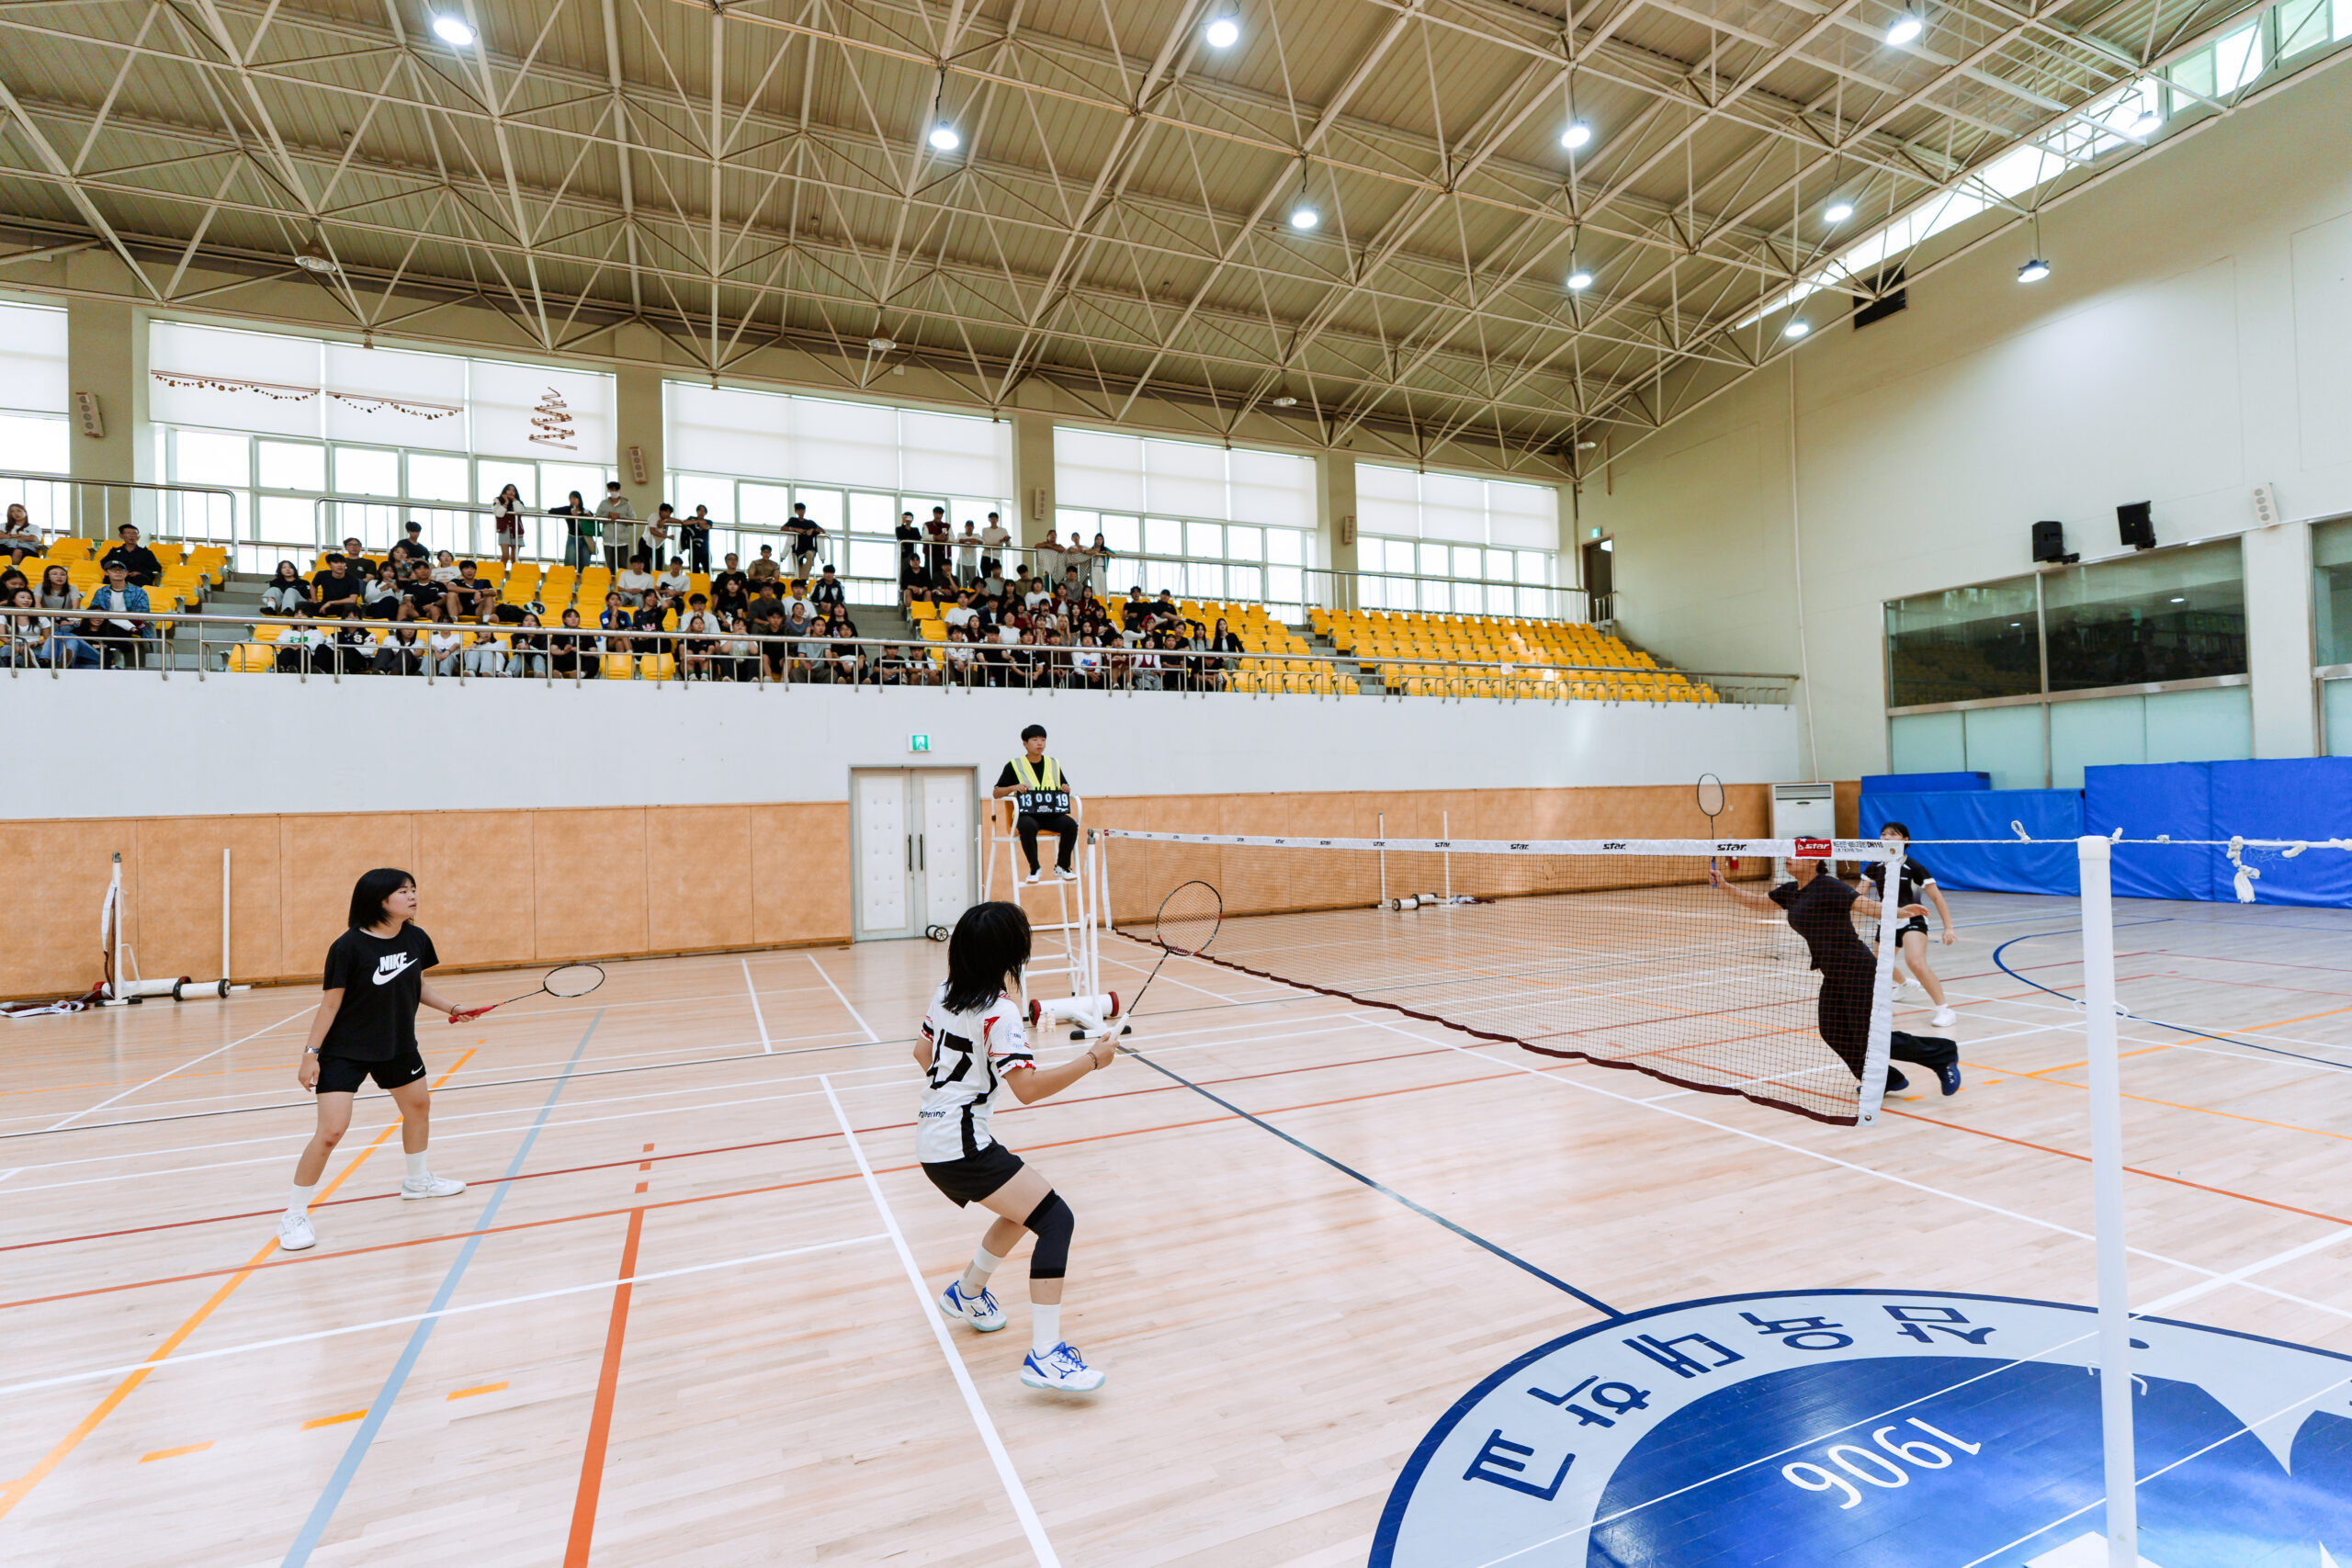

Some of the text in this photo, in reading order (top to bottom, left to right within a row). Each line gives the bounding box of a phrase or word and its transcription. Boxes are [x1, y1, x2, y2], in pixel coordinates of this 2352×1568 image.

[1020, 793, 1069, 807] 13 0 0 19
[1510, 842, 1529, 851] star
[1603, 842, 1625, 851] star
[1717, 843, 1747, 852] star
[379, 952, 408, 972] NIKE
[1462, 1305, 1997, 1503] 삼육대학교
[1781, 1416, 1982, 1510] 1906
